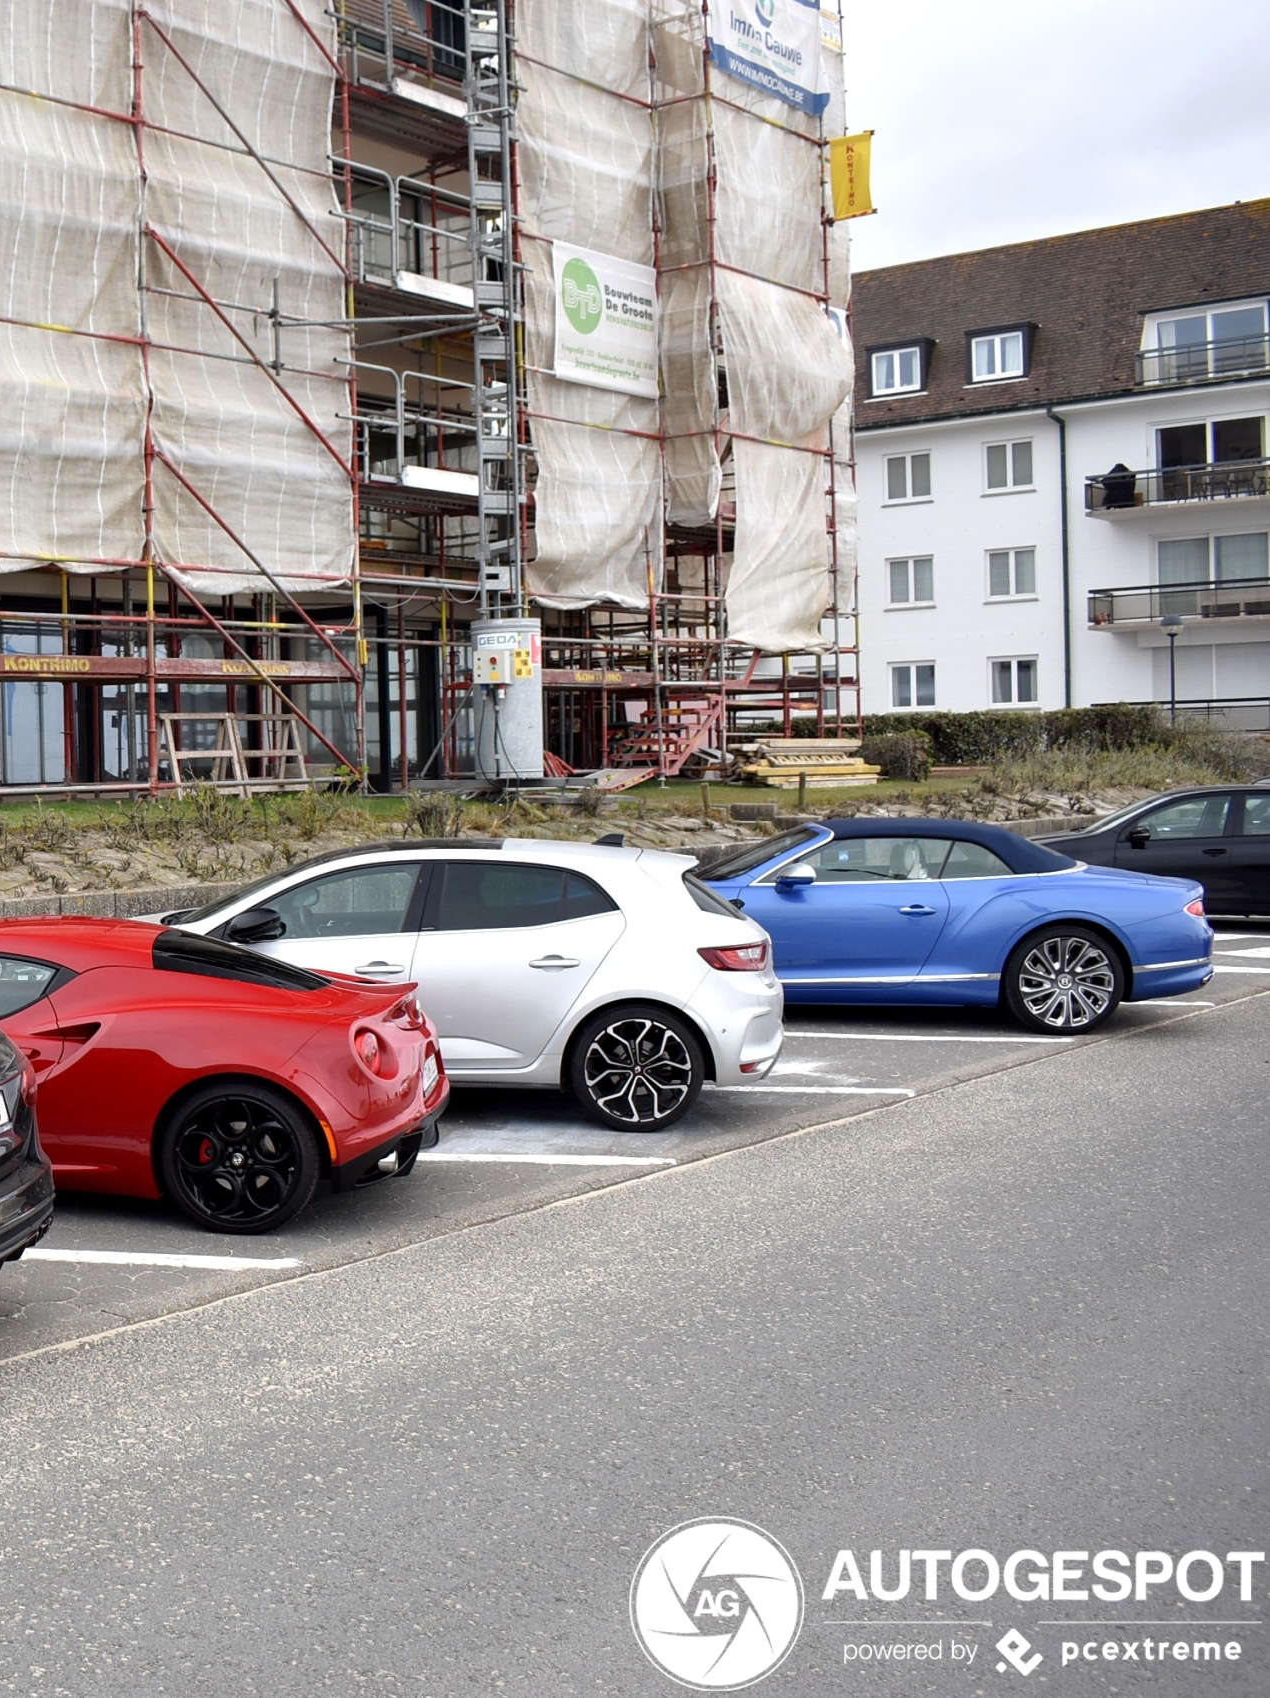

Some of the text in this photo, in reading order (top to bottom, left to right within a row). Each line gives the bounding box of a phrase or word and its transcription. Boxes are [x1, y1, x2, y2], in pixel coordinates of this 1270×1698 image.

[765, 31, 802, 66] Cauwe
[845, 145, 855, 207] KONTRIMO
[604, 284, 653, 308] Bouwteam
[605, 298, 654, 322] De Groote
[479, 634, 518, 646] GEDA
[4, 655, 91, 672] KONTRIMO
